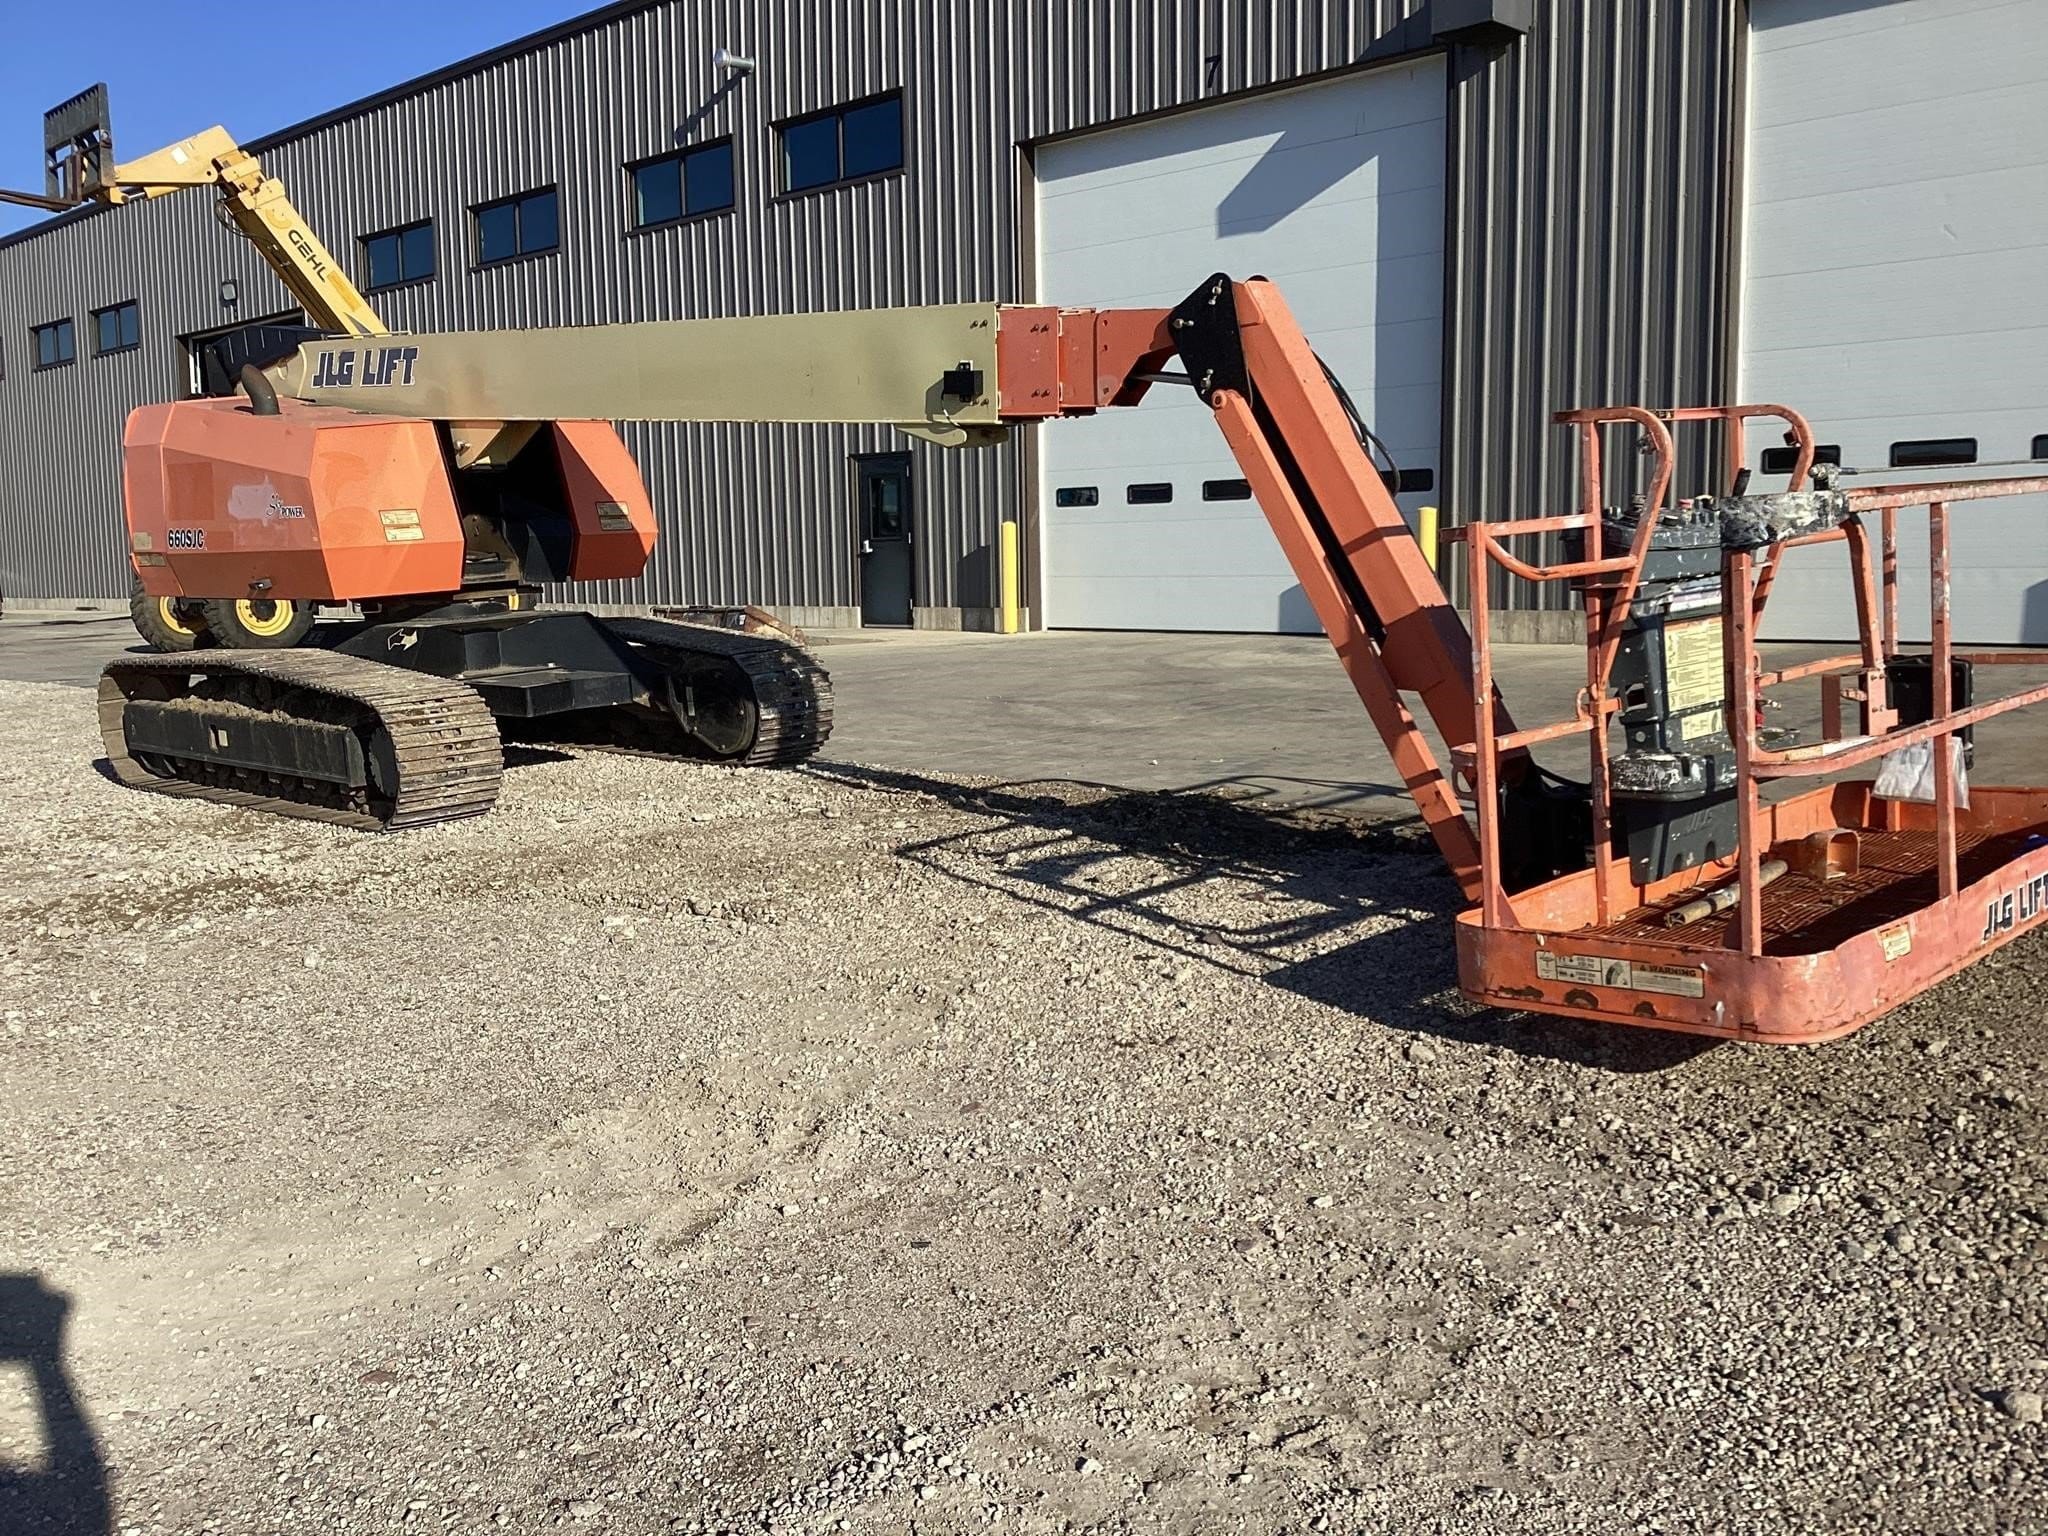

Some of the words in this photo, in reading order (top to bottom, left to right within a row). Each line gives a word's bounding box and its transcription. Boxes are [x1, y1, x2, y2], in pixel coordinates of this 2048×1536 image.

[1204, 54, 1222, 89] 7
[287, 229, 326, 283] GEHL
[312, 350, 355, 388] JLG
[360, 346, 419, 387] LIFT
[281, 506, 304, 518] POWER
[167, 528, 205, 549] 660SJC
[1982, 892, 2014, 942] JLG
[1649, 965, 1697, 977] WARNING
